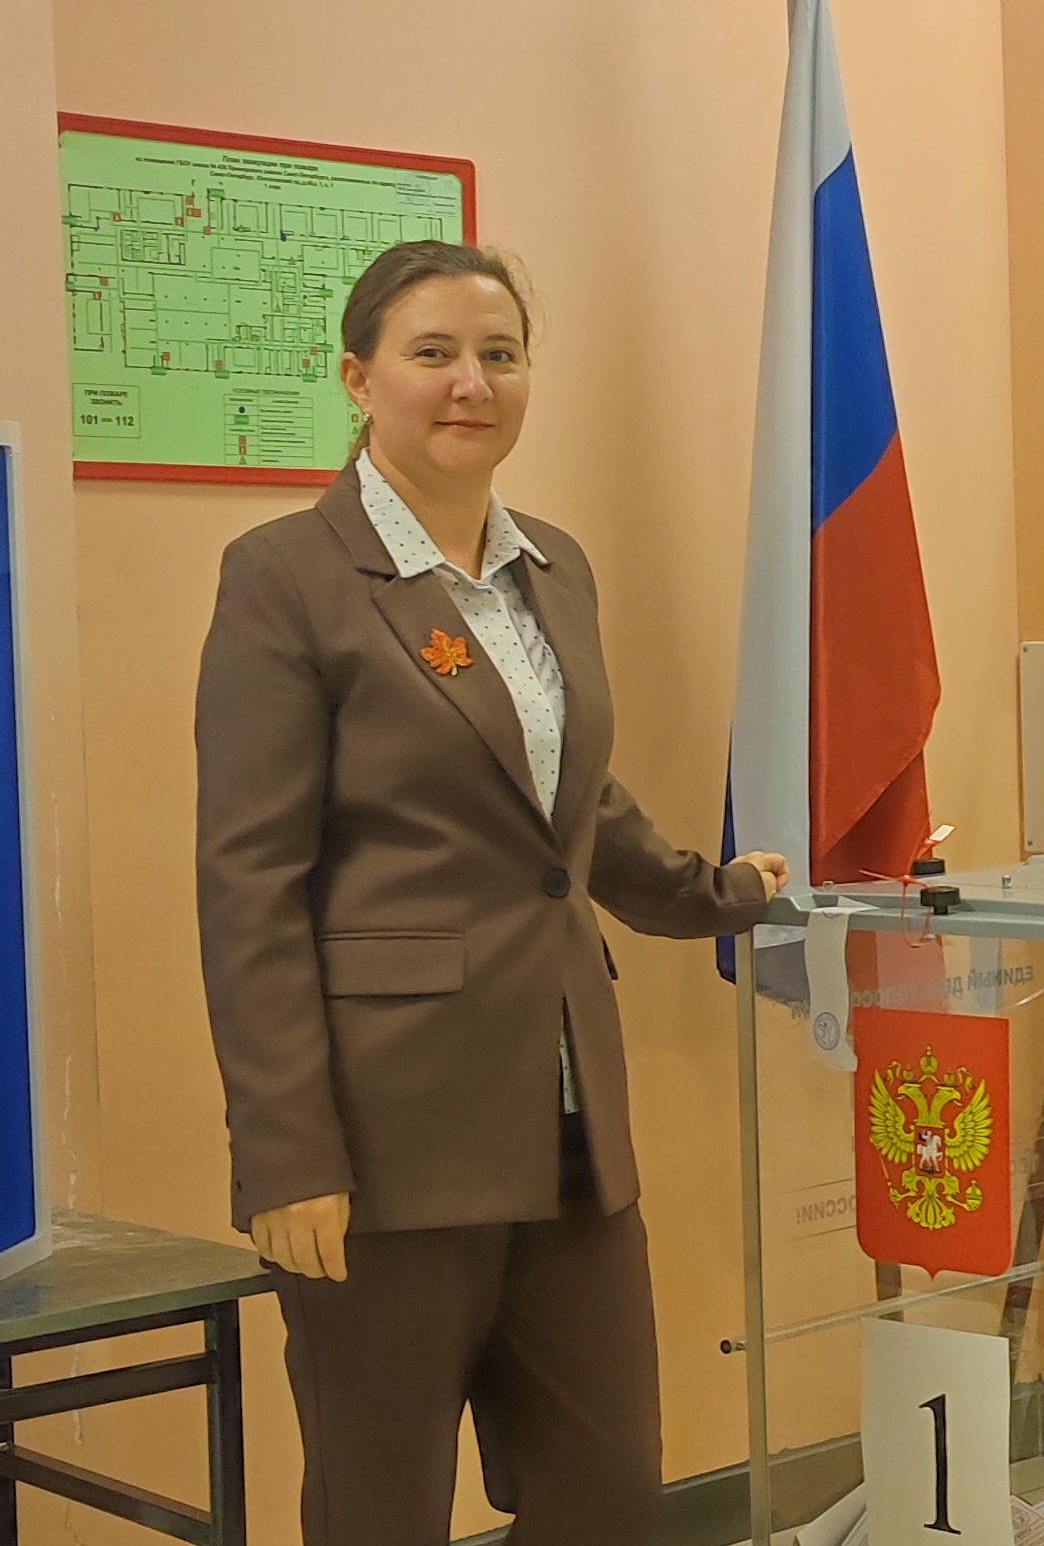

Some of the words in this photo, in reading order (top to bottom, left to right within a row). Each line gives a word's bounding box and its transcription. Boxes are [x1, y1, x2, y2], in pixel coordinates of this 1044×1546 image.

[80, 413, 98, 425] 101
[115, 415, 135, 427] 112
[918, 1393, 962, 1535] 1
